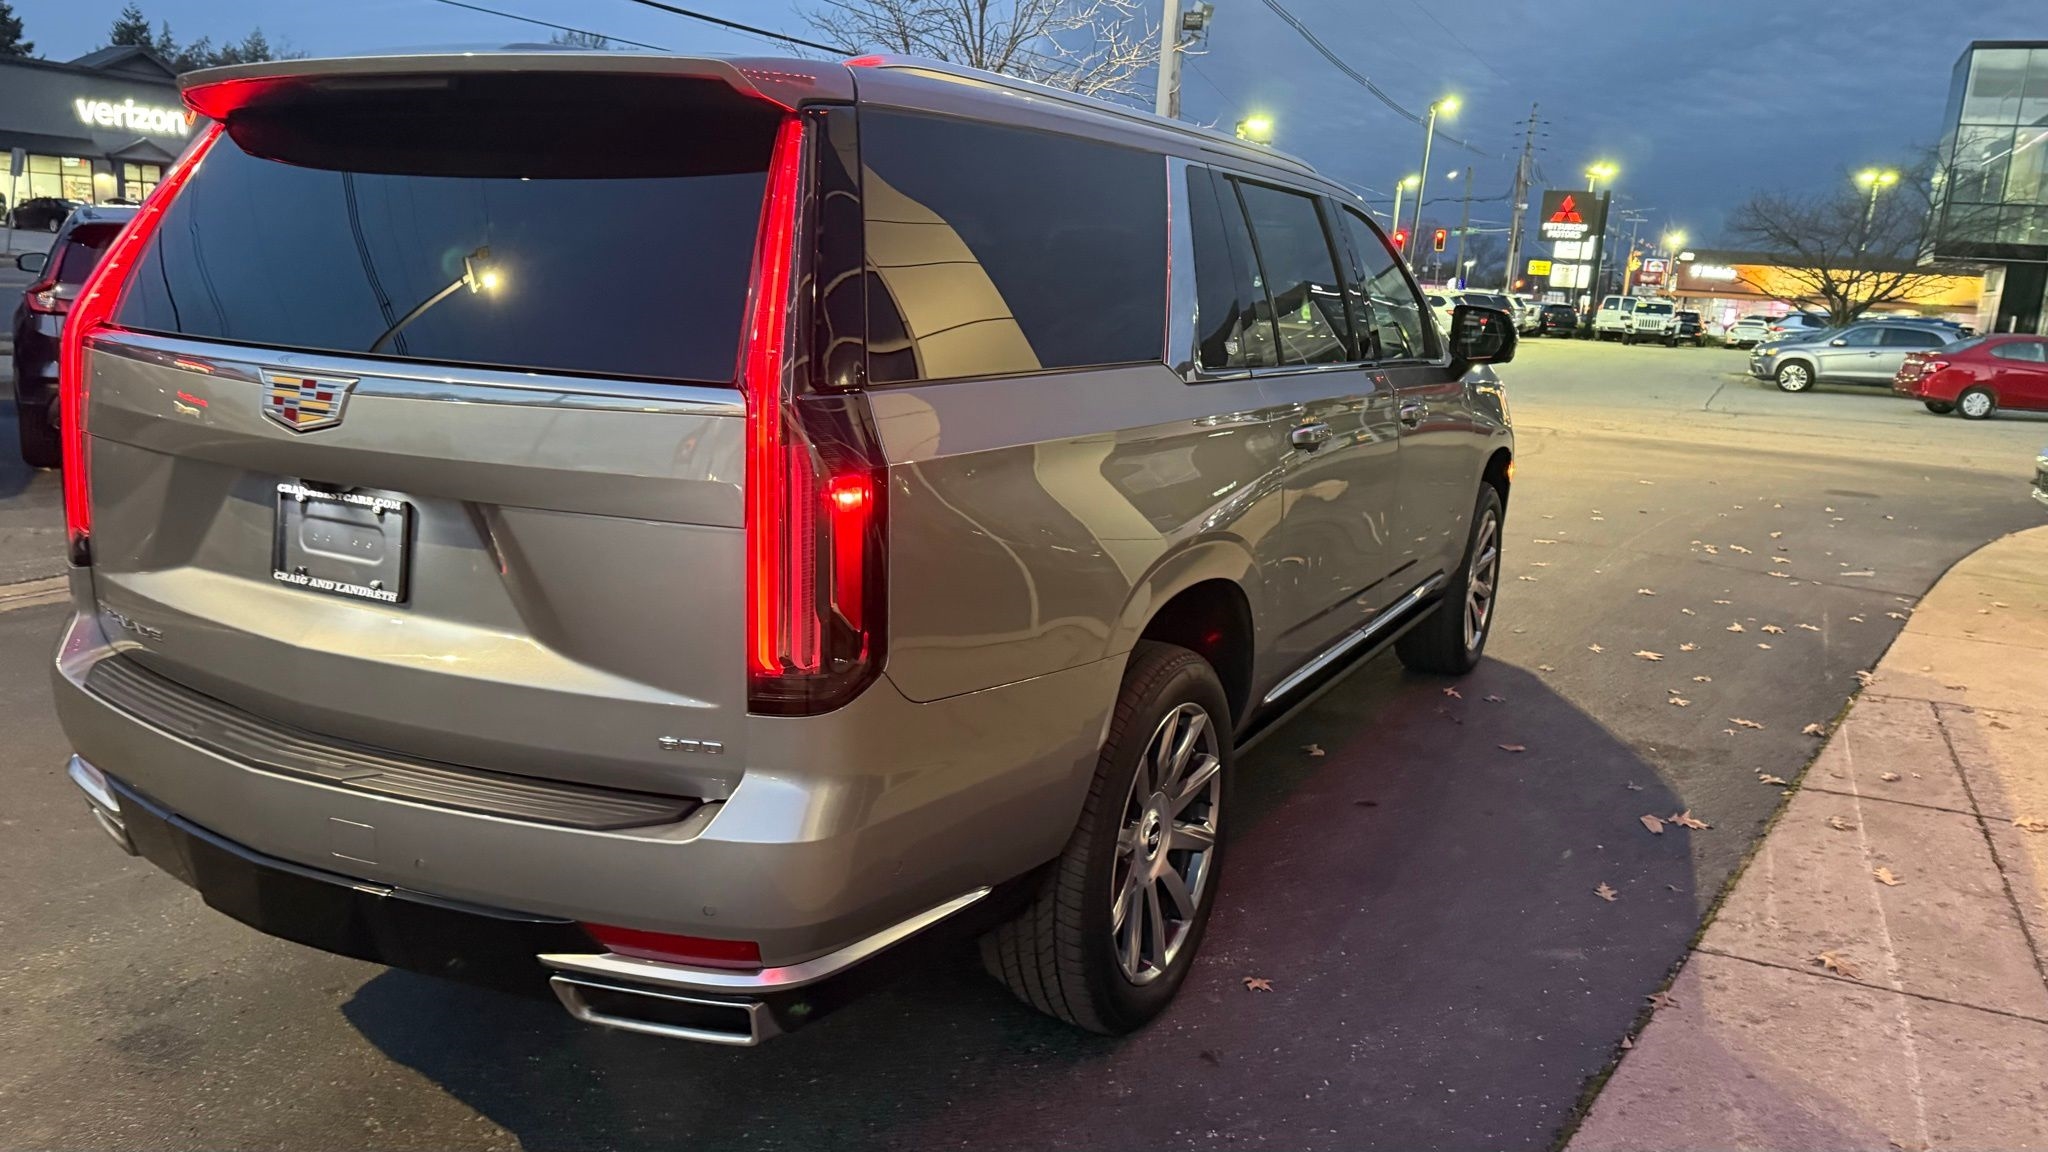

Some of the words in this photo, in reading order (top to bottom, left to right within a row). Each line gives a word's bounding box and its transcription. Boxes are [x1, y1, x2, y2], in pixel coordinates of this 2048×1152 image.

[75, 97, 188, 135] verizon
[273, 571, 309, 585] CRAIG
[308, 578, 334, 590] AND
[335, 582, 398, 603] LANDRETH
